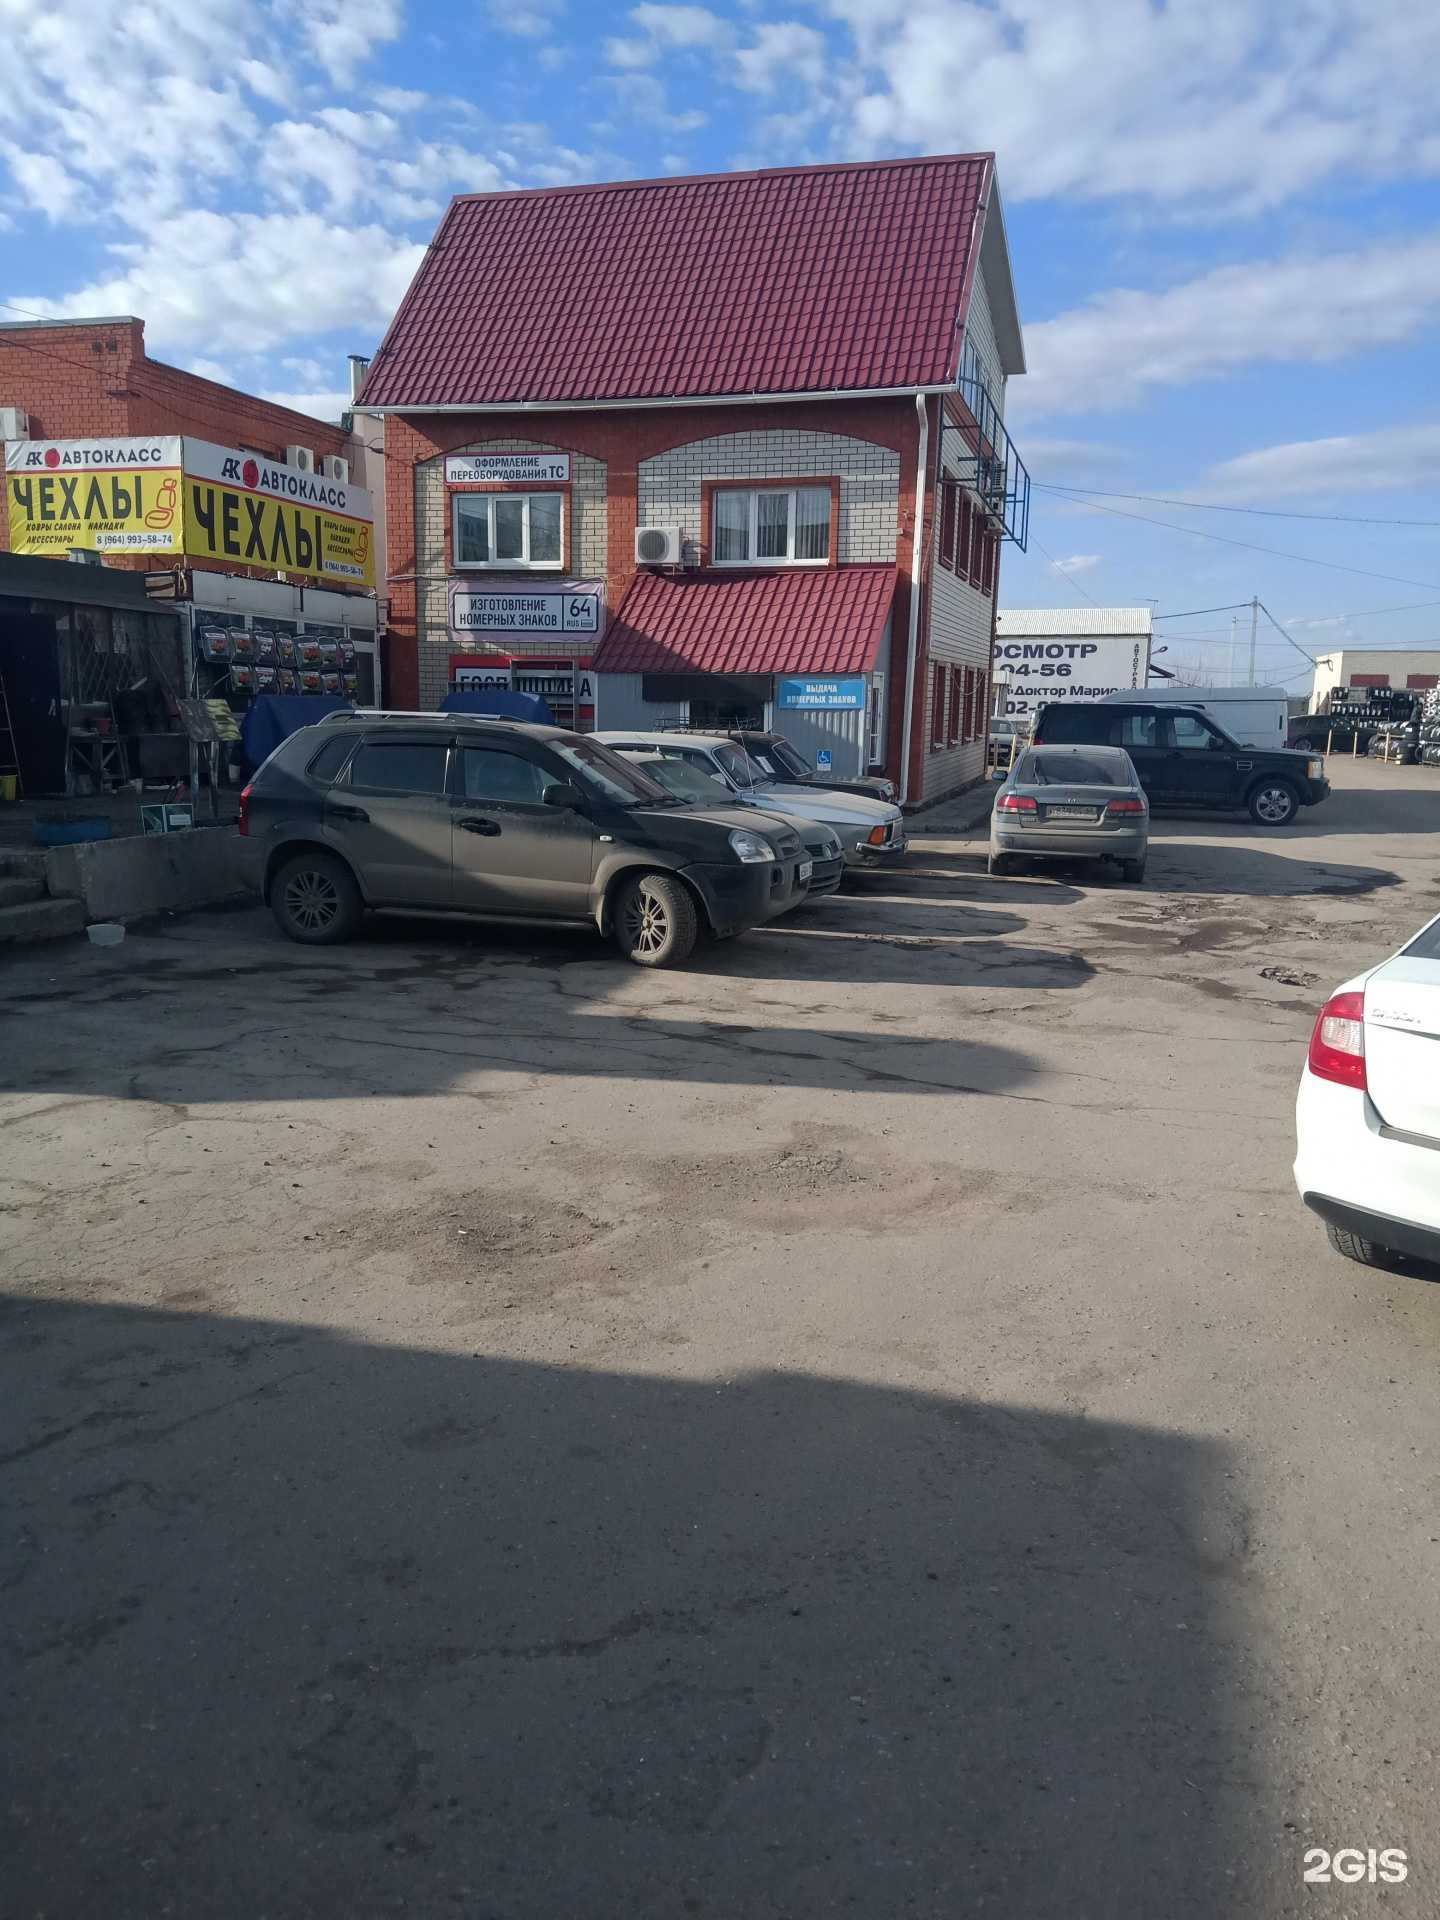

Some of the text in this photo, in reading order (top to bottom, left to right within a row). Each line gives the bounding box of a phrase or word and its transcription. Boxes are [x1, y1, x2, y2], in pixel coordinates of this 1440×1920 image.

[62, 448, 162, 465] АВТОКЛАСС
[475, 457, 540, 468] ОФОРМЛЕНИЕ
[451, 465, 564, 480] ПЕРЕОБОРУДОВАНИЯ ТС
[260, 468, 346, 509] АВТОКЛАСС
[13, 476, 143, 521] ЧЕХЛЫ
[26, 521, 125, 532] КОВРЫ САЛОНА НАКИДКИ
[192, 485, 323, 571] ЧЕХЛЫ
[26, 535, 74, 544] АКСЕССУАРЫ
[470, 599, 547, 611] ИЗГОТОВЛЕНИЕ
[570, 599, 591, 617] 64
[459, 613, 558, 627] НОМЕРНЫХ ЗНАКОВ
